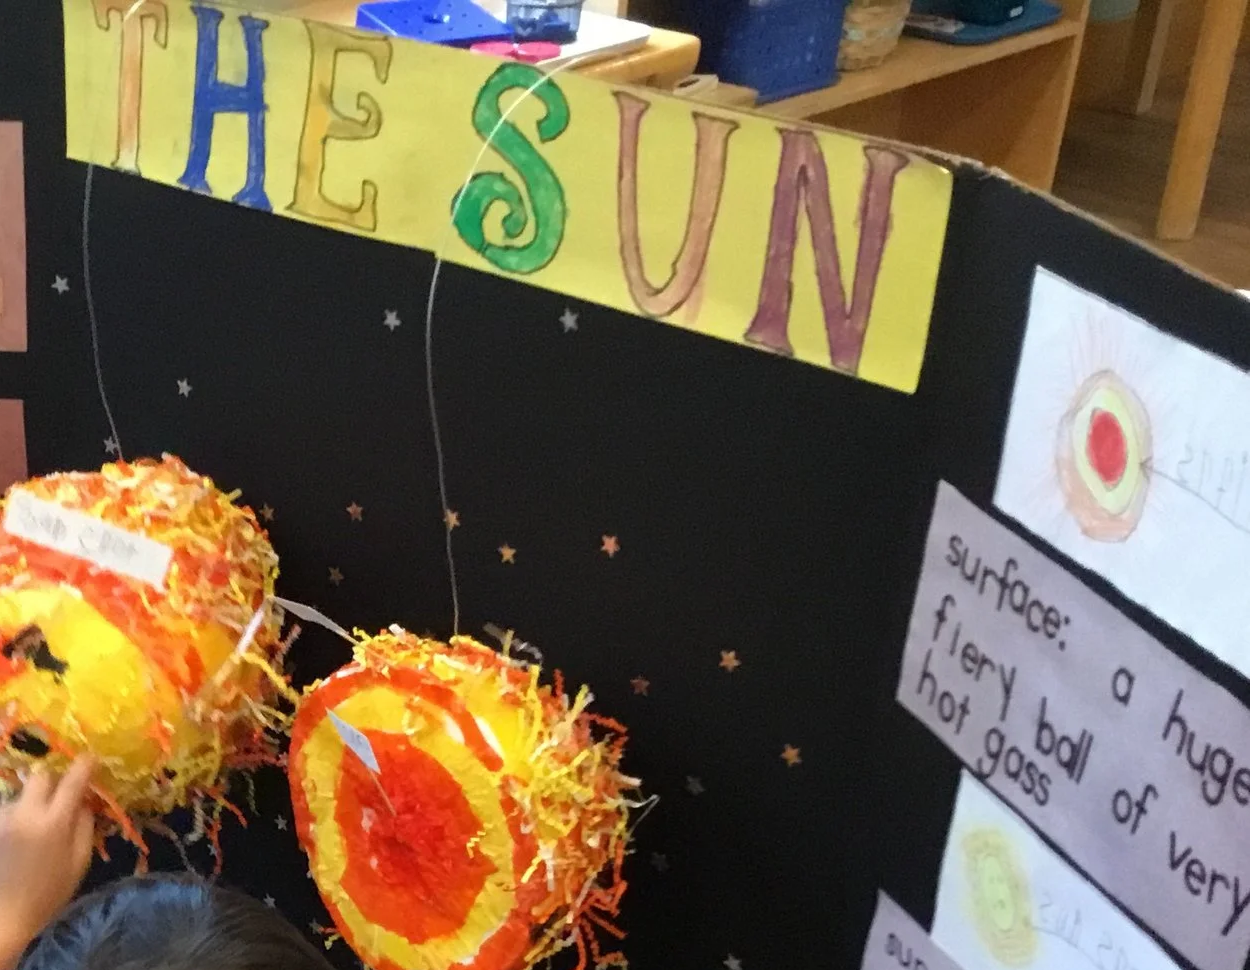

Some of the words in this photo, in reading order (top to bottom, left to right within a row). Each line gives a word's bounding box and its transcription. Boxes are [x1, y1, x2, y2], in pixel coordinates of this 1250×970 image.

[95, 0, 393, 233] THE
[450, 62, 909, 375] SUN
[917, 648, 970, 734] hot
[975, 725, 1052, 807] gass
[947, 533, 1071, 651] surface:
[1111, 665, 1134, 706] a
[934, 593, 1017, 722] fiery
[1034, 696, 1094, 785] ball
[1112, 783, 1158, 836] of
[1168, 830, 1250, 937] very
